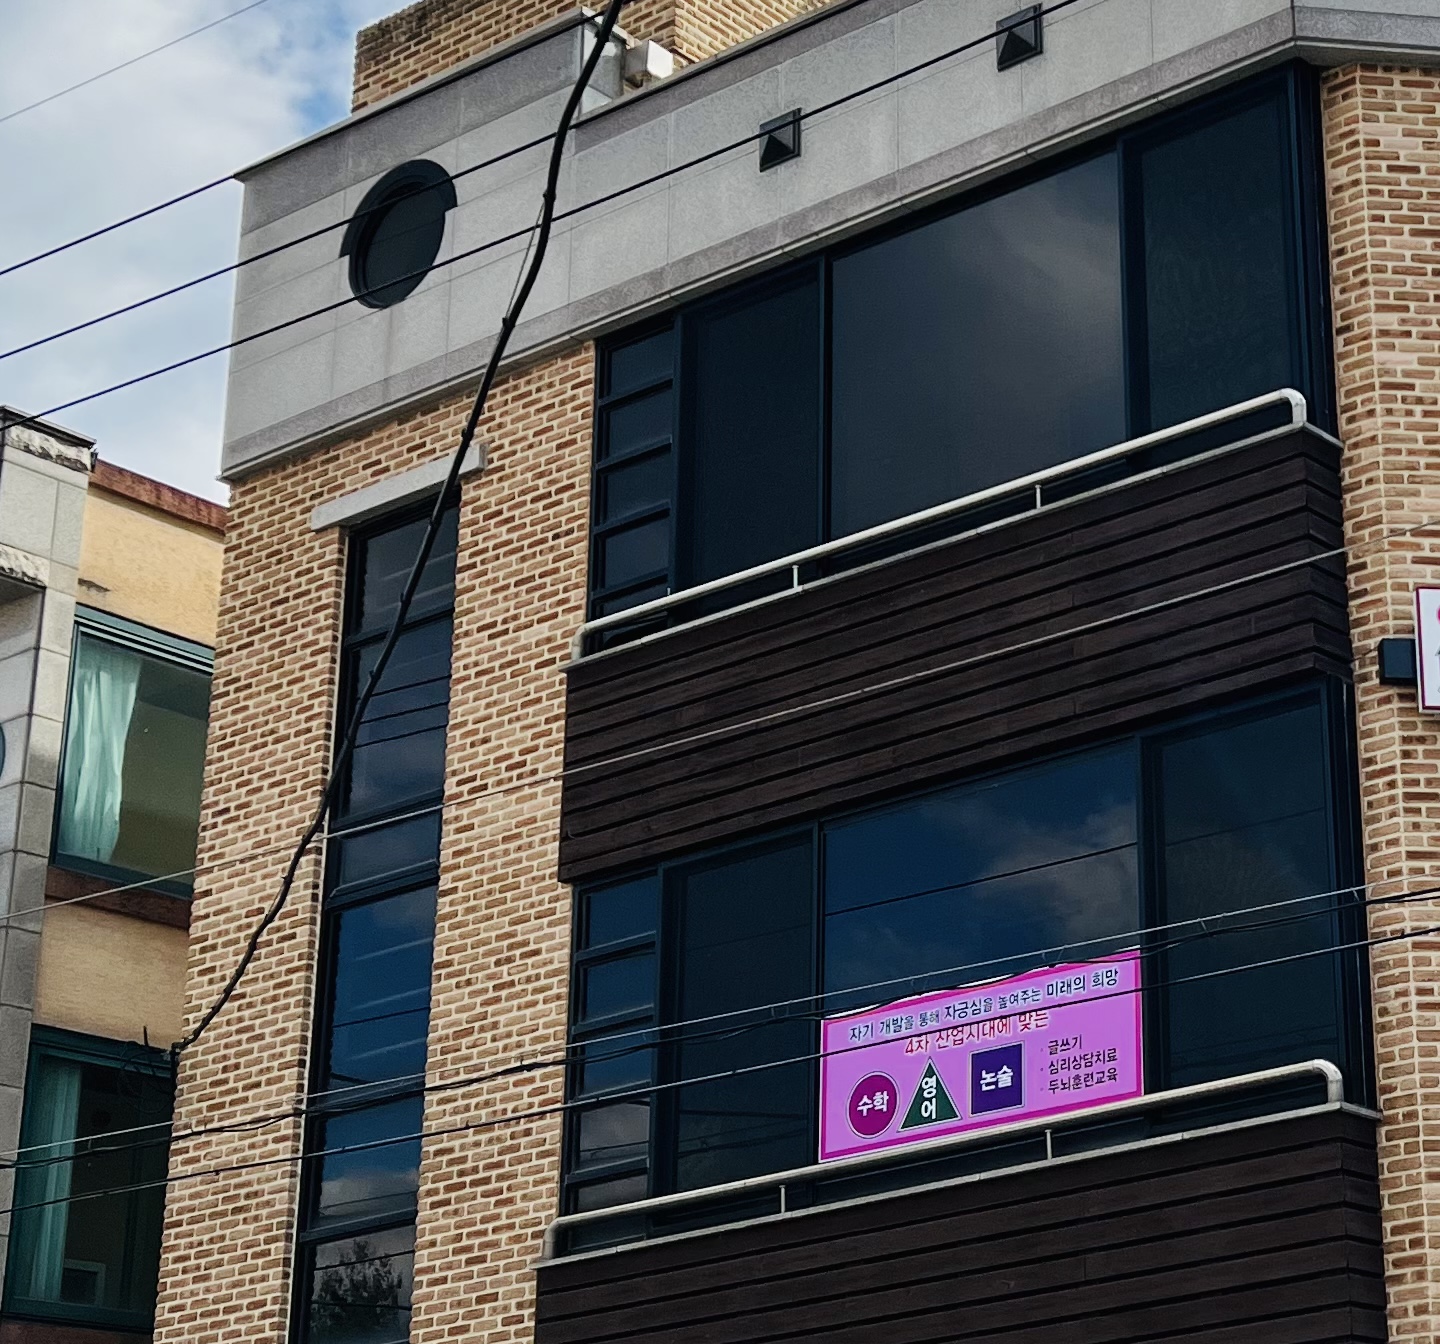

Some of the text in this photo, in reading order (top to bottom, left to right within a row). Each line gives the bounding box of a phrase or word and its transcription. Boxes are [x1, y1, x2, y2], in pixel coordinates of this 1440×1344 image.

[849, 968, 1119, 1041] 자기 개발을 통해 자긍심을 높여주는 미래의 희망
[935, 1014, 1011, 1049] 산업시대에
[1048, 1033, 1082, 1056] 글쓰기
[1048, 1047, 1118, 1075] 심리상담치료
[979, 1064, 1014, 1091] 논술
[1048, 1067, 1119, 1095] 두뇌훈련교육
[856, 1090, 890, 1116] 수학
[920, 1074, 937, 1120] 영어
